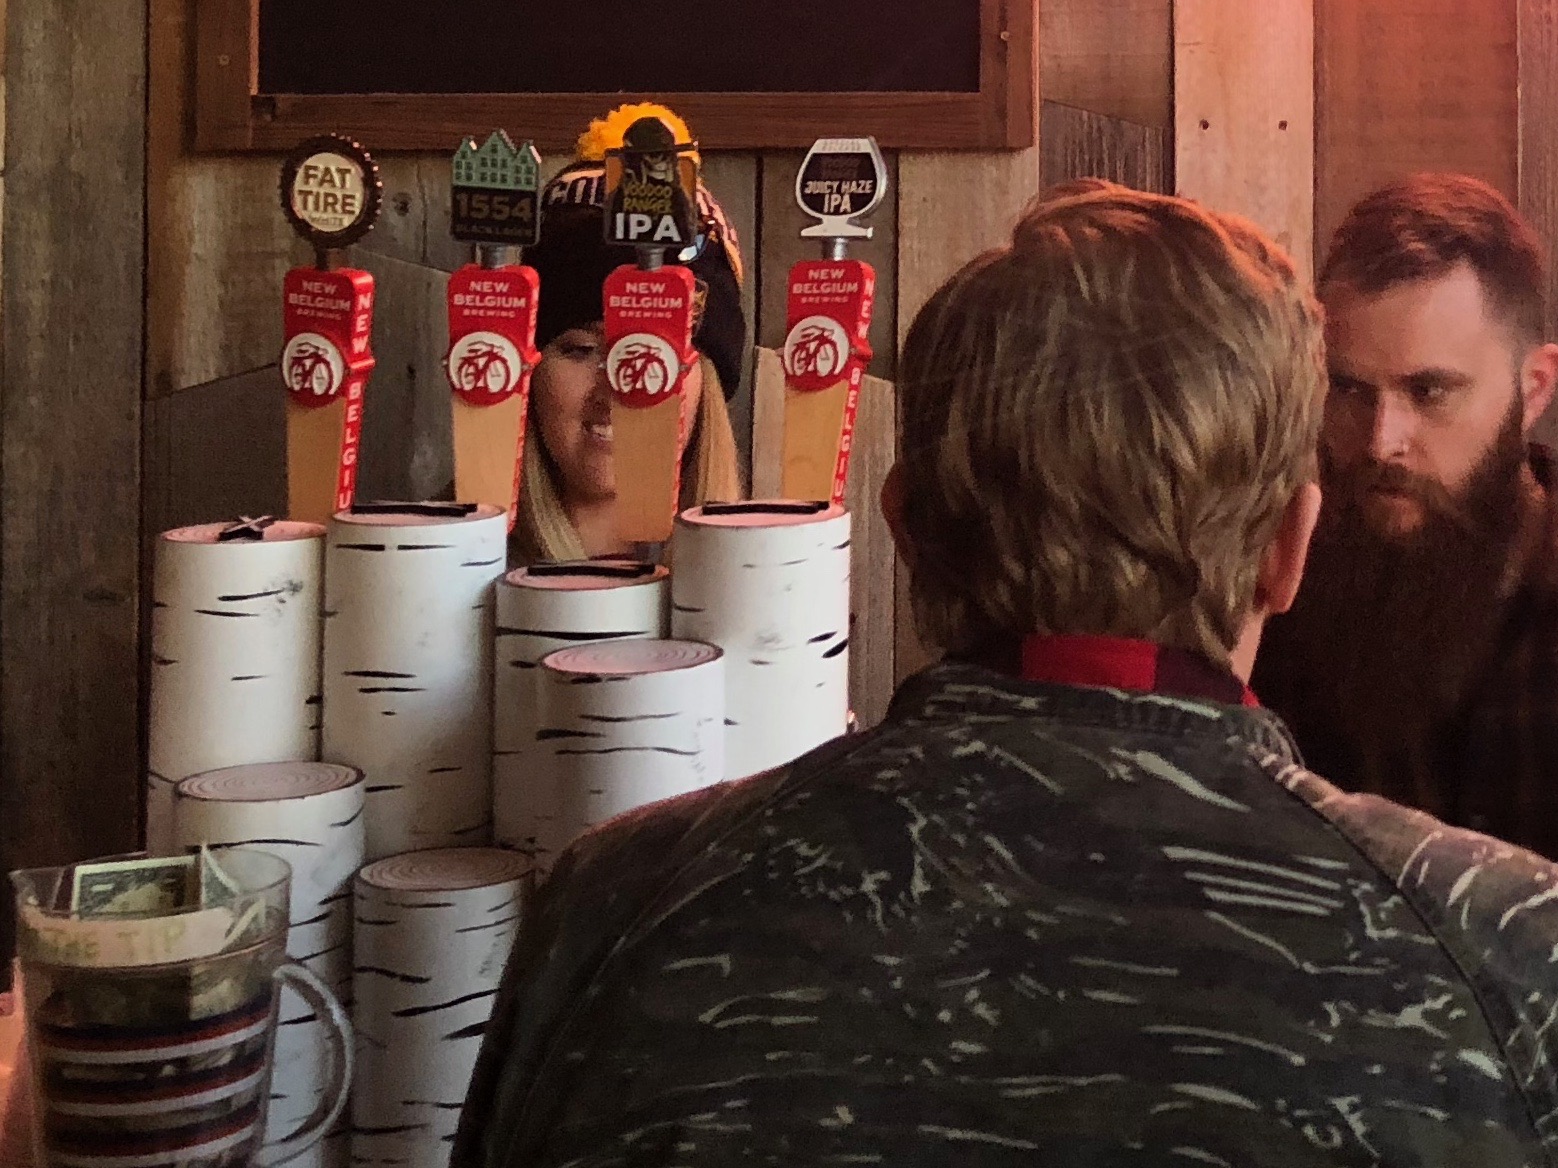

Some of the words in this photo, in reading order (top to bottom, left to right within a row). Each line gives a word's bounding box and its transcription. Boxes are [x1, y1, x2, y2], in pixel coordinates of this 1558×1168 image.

[302, 164, 352, 189] FAT
[623, 182, 673, 197] VOODOO
[804, 180, 840, 195] JUICY
[841, 179, 874, 194] HAZE
[298, 189, 356, 215] TIRE
[456, 192, 533, 223] 1554
[823, 193, 852, 214] IPA
[615, 212, 682, 243] IPA
[808, 268, 845, 280] NEW
[302, 280, 337, 294] NEW
[469, 280, 510, 293] NEW
[625, 282, 666, 294] NEW
[792, 282, 859, 295] BELGIUM
[288, 293, 351, 311] BELGIUM
[453, 293, 527, 309] BELGIUM
[609, 295, 683, 309] BELGIUM
[353, 292, 372, 354] NEW
[834, 367, 861, 496] BELGIU
[338, 382, 363, 510] BELGIU
